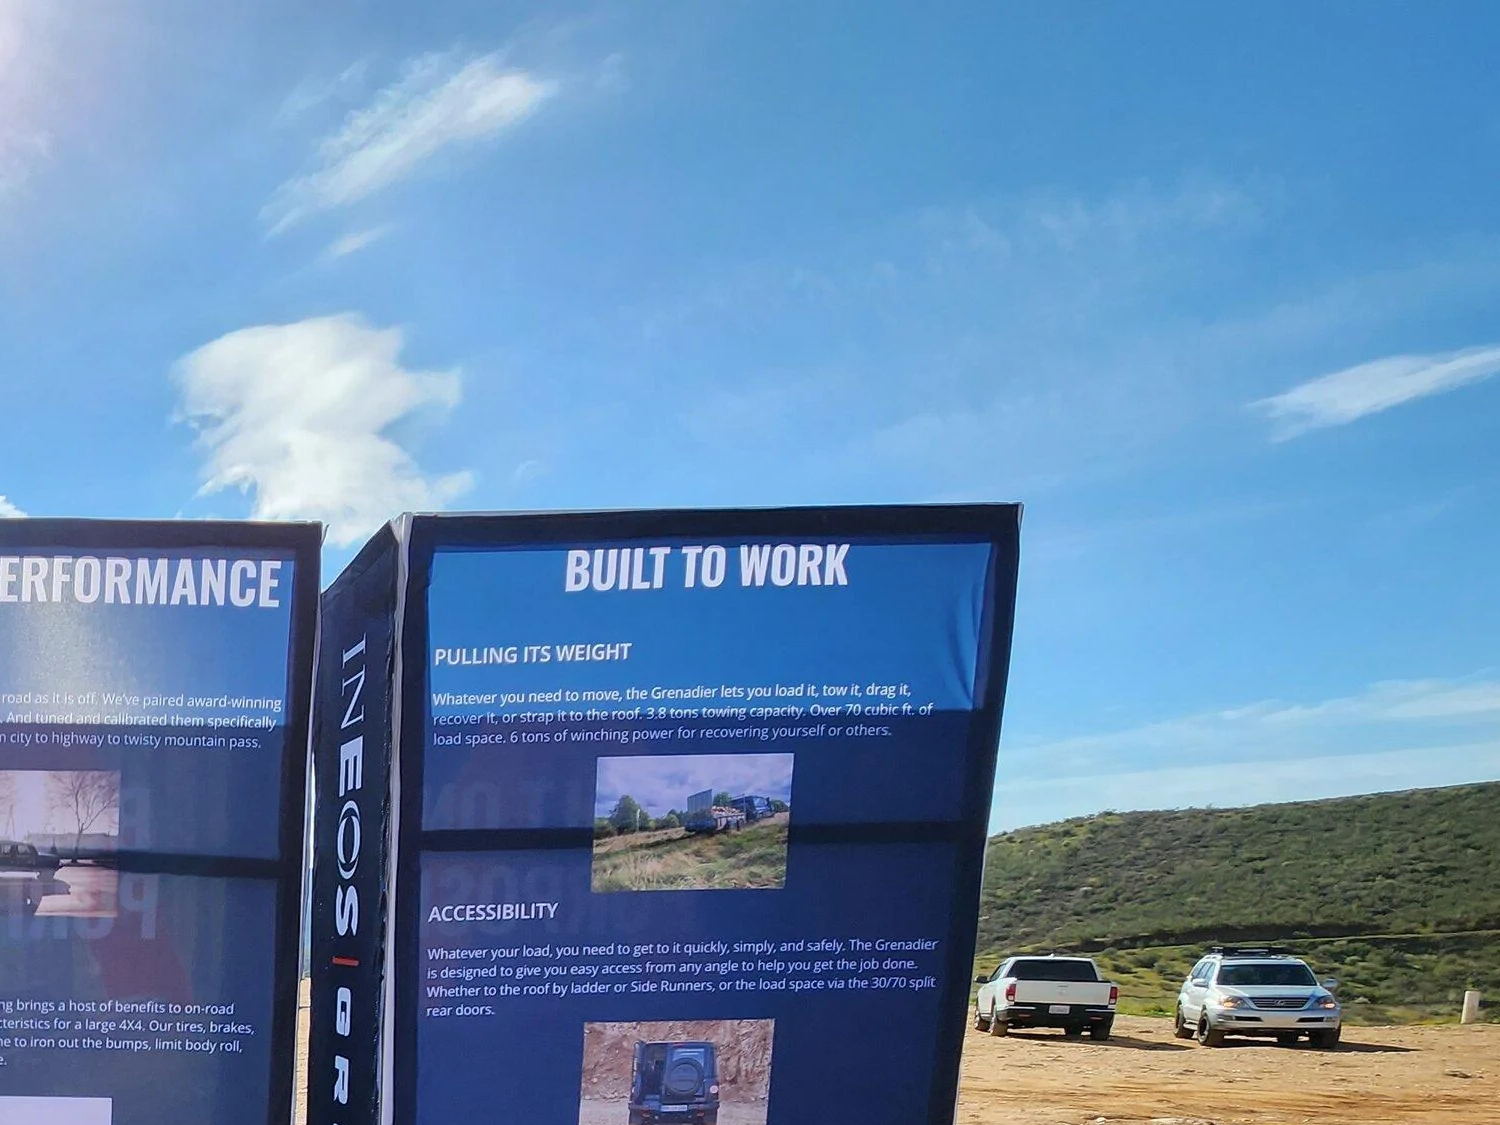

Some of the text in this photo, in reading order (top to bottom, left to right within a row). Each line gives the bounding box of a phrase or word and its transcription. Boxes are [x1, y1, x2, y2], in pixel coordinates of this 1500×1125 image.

[565, 542, 850, 592] BUILT TO WORK
[435, 642, 632, 665] PULLING ITS WEIGHT
[9, 732, 32, 746] city
[35, 732, 48, 743] to
[51, 731, 104, 748] highway
[107, 733, 120, 745] to
[123, 734, 161, 749] twisty
[164, 735, 225, 747] mountain
[433, 723, 891, 747] load space. 6 tons of winching power for recovering yourself or others.
[334, 632, 367, 937] INEOS
[427, 902, 558, 922] ACCESSIBILITY
[427, 937, 938, 961] Whatever your load, you need to get to it quickly, simply, and safely. The Grenadier
[426, 1003, 494, 1016] rear doors.
[53, 1017, 71, 1030] for
[74, 1021, 82, 1029] a
[85, 1018, 116, 1033] large
[118, 1019, 145, 1031] 4X4.
[148, 1019, 173, 1031] Our
[175, 1020, 206, 1034] tires,
[209, 1020, 255, 1035] brakes,
